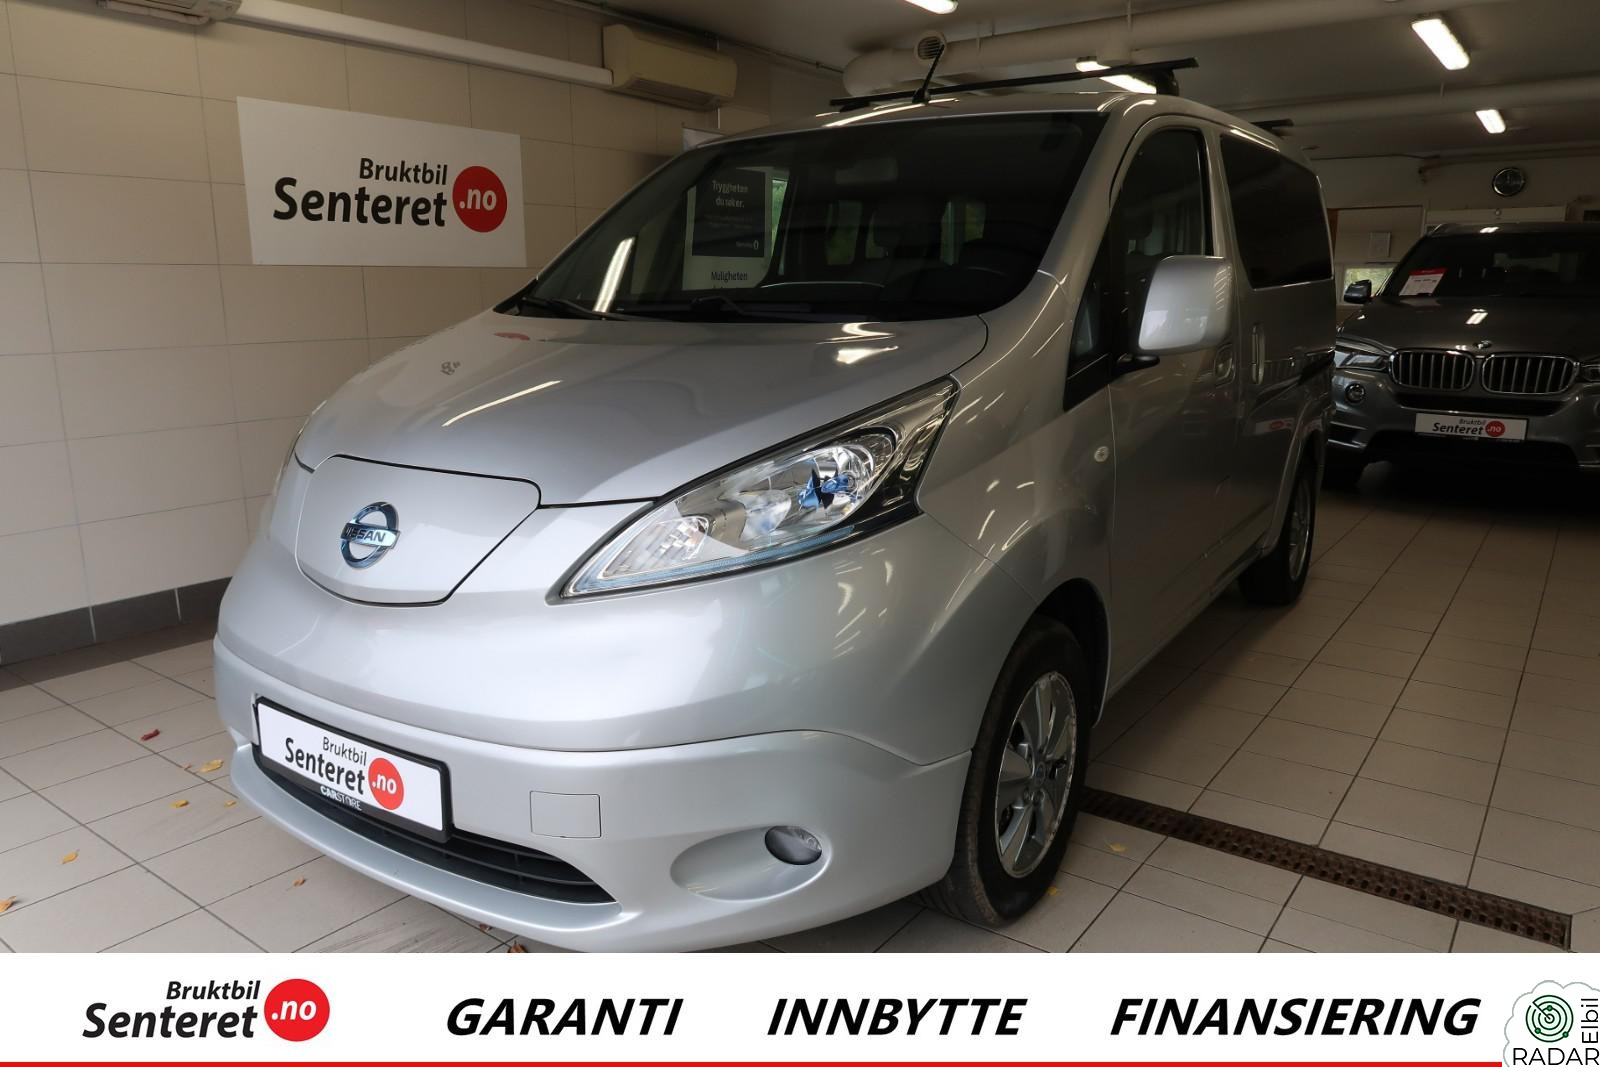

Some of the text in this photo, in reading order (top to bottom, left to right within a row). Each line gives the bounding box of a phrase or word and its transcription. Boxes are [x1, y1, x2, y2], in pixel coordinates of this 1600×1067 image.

[359, 157, 448, 187] Bruktbil
[272, 177, 498, 227] Senteret .no
[1432, 422, 1502, 435] Senteret .no
[1459, 418, 1486, 427] Bruktbil
[344, 525, 386, 543] NISSAN
[285, 737, 397, 795] Senteret .no
[322, 736, 367, 766] Bruktbil
